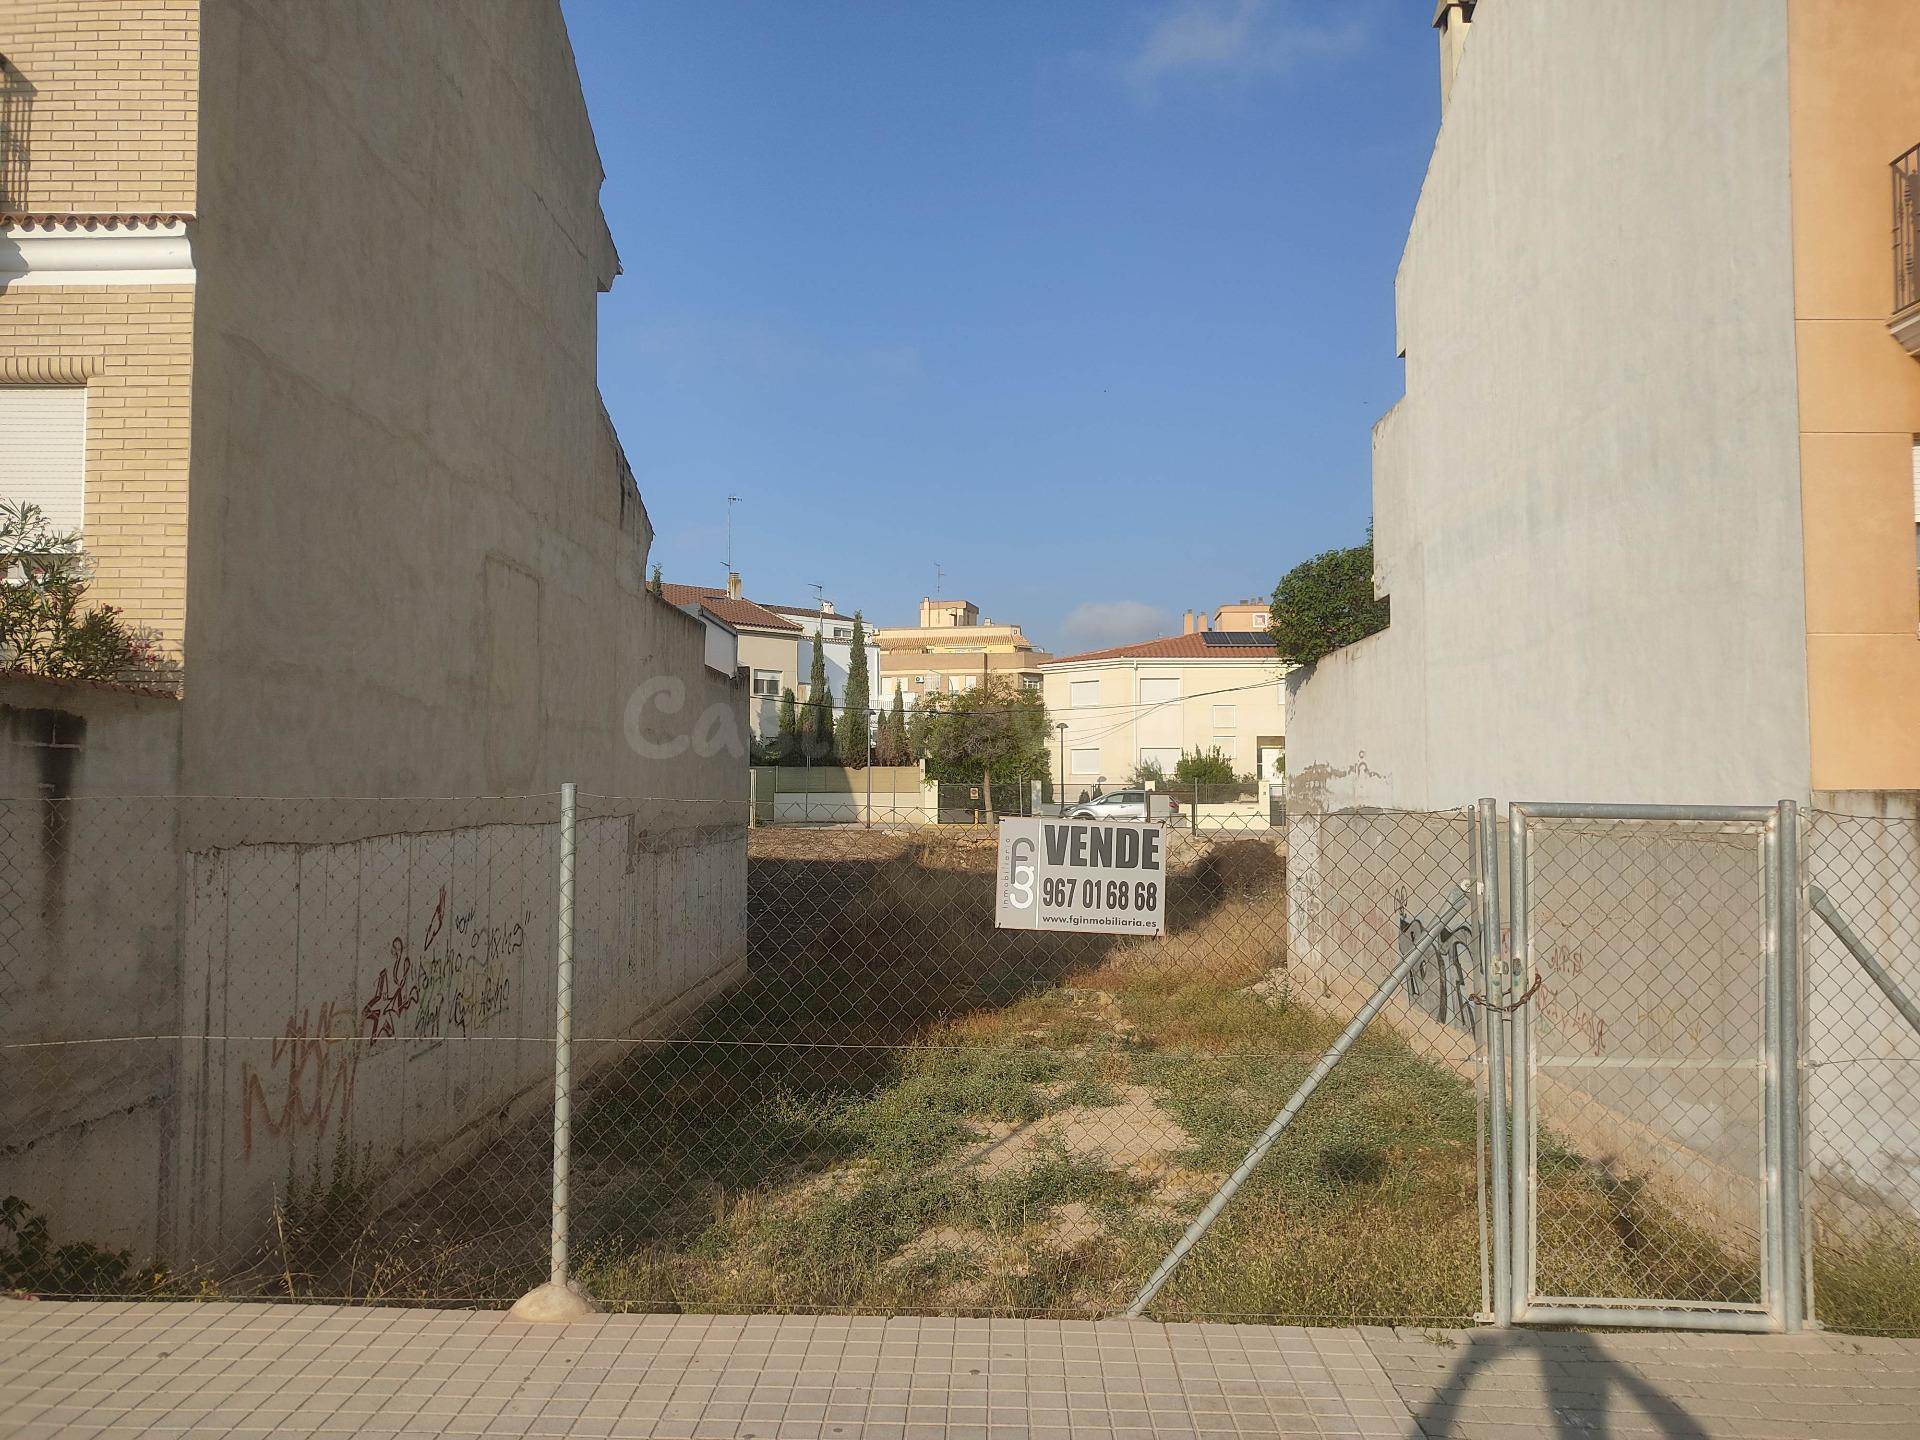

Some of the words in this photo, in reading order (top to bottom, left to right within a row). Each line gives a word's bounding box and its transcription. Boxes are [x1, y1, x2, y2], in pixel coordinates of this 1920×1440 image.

[1045, 825, 1160, 870] VENDE
[1043, 877, 1076, 907] 967
[1082, 879, 1102, 909] 01
[1106, 880, 1129, 910] 68
[1134, 881, 1158, 912] 68
[1042, 915, 1157, 928] www.fginmobiliaria.es
